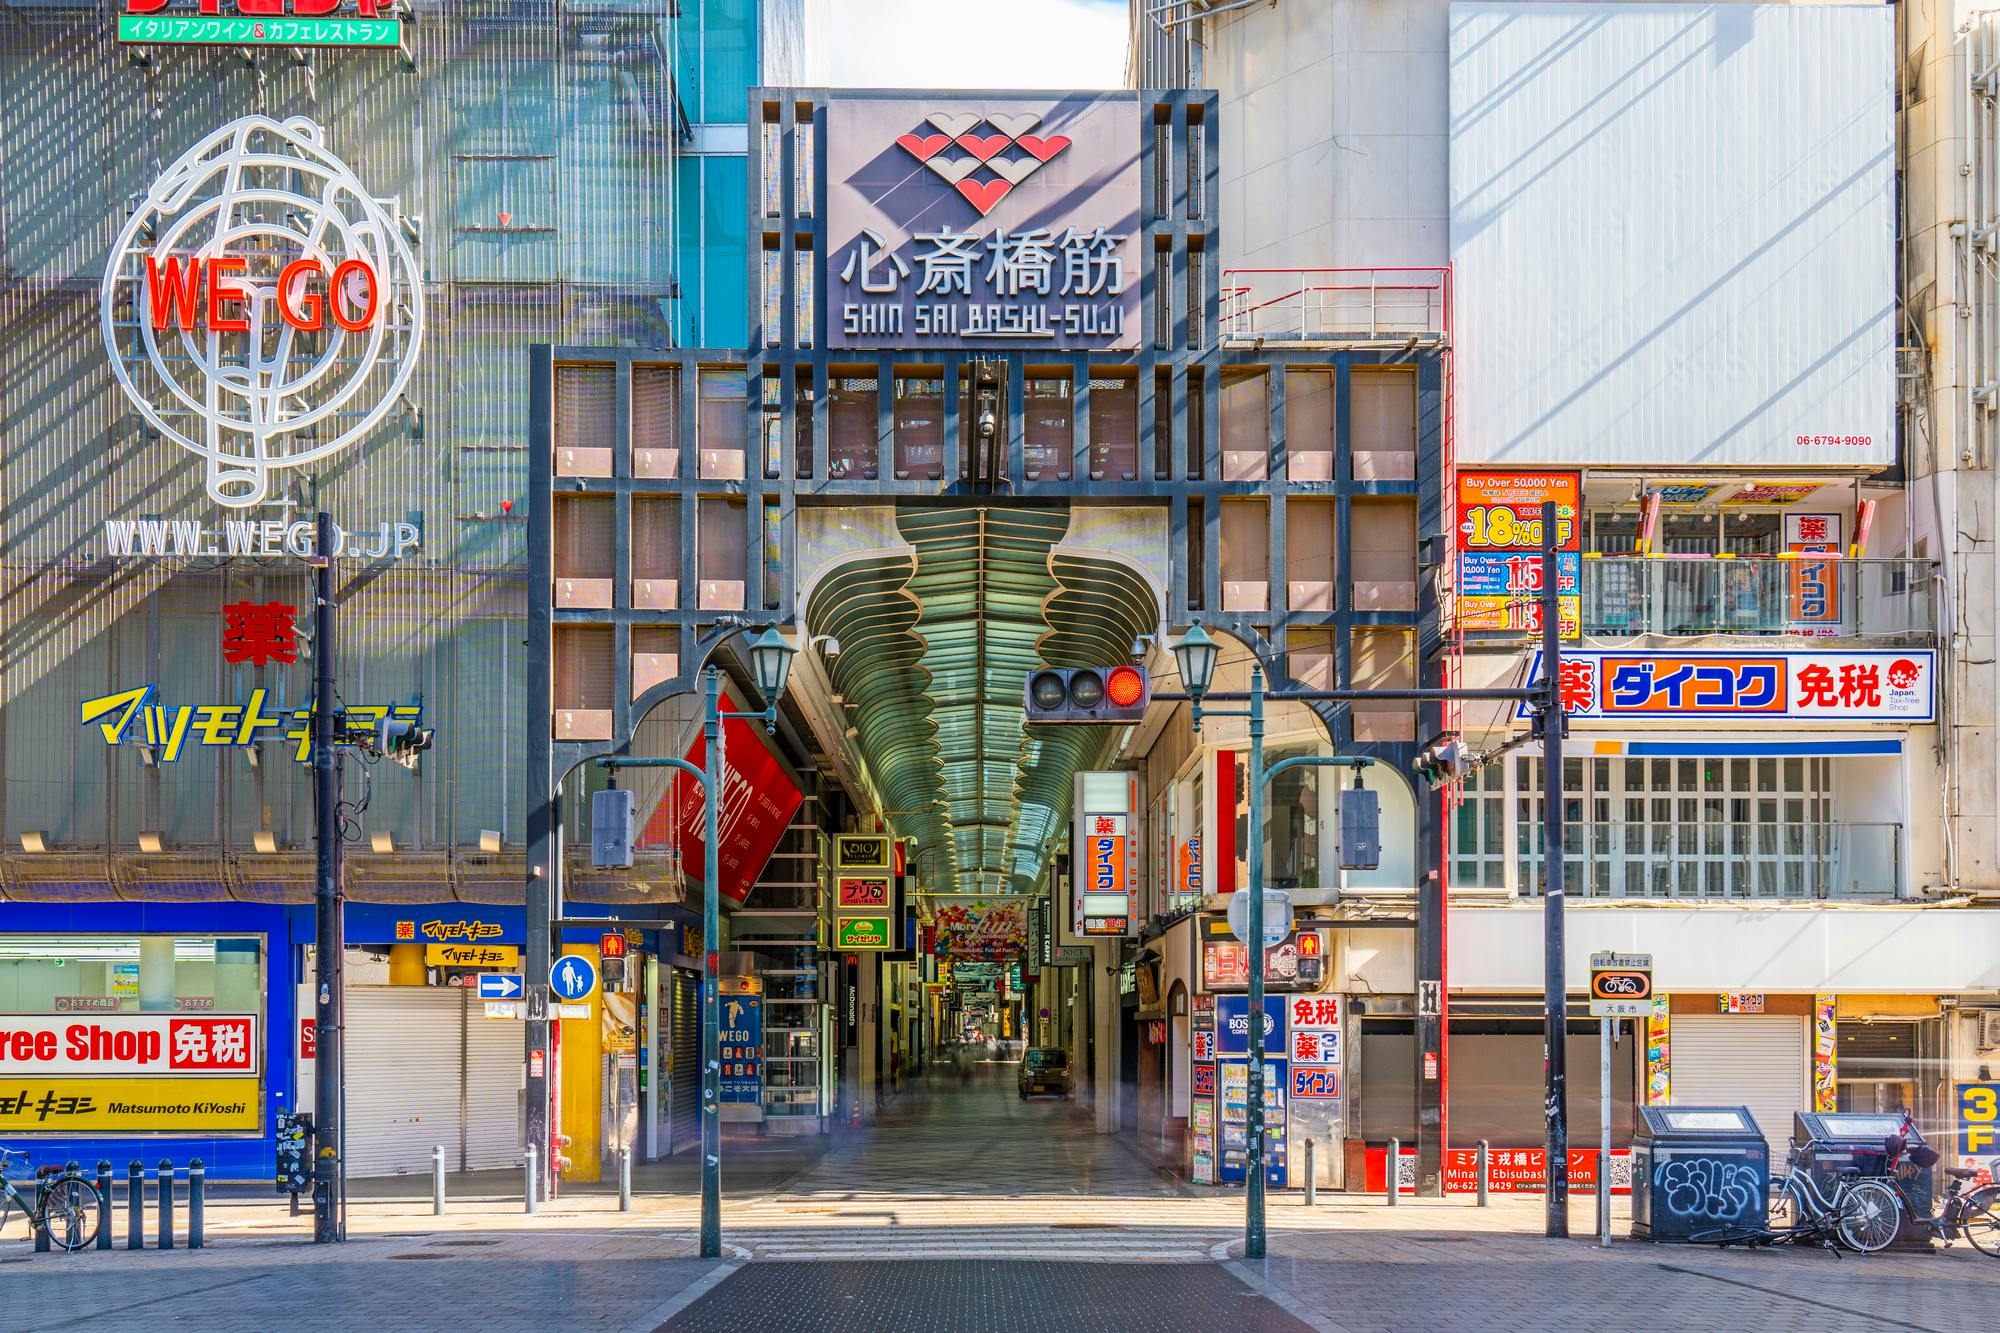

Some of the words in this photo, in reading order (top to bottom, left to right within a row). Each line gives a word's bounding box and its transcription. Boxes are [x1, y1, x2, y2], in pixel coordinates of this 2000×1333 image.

[840, 225, 1129, 297] 心斎橋筋
[146, 257, 249, 332] WE
[277, 259, 377, 333] GO
[844, 303, 904, 335] SHIN
[915, 303, 958, 335] SAI
[1796, 434, 1872, 447] 06-6794-9090
[1466, 478, 1485, 488] Buy
[1487, 478, 1511, 487] Over
[1514, 478, 1546, 488] 50,000
[1550, 478, 1568, 487] Yen
[1799, 516, 1829, 541] 薬
[1464, 601, 1478, 609] Buy
[1480, 600, 1497, 608] Over
[222, 600, 298, 666] 薬
[1611, 662, 1777, 708] ダイコク
[1796, 663, 1882, 708] 免税
[1888, 704, 1909, 712] Shop
[1095, 816, 1116, 834] 薬
[1097, 838, 1115, 889] ダイコク
[872, 888, 882, 897] 7F
[397, 922, 414, 938] 薬
[423, 920, 503, 941] マツモトキヨシ
[846, 934, 881, 943] サイゼリヤ
[441, 947, 504, 964] マツモトキヨシ
[1294, 999, 1338, 1025] 免税
[1606, 1005, 1637, 1014] 大阪市
[1229, 1018, 1248, 1029] BOS
[66, 1024, 160, 1064] Shop
[174, 1023, 246, 1064] 免税
[1296, 1032, 1319, 1061] 薬
[1295, 1071, 1336, 1094] ダイコク
[108, 1102, 191, 1114] Matsumoto
[193, 1102, 246, 1114] KiYoshi
[1963, 1087, 1998, 1153] 3F
[1447, 1169, 1478, 1179] Mina
[1493, 1169, 1546, 1179] Ebisubash
